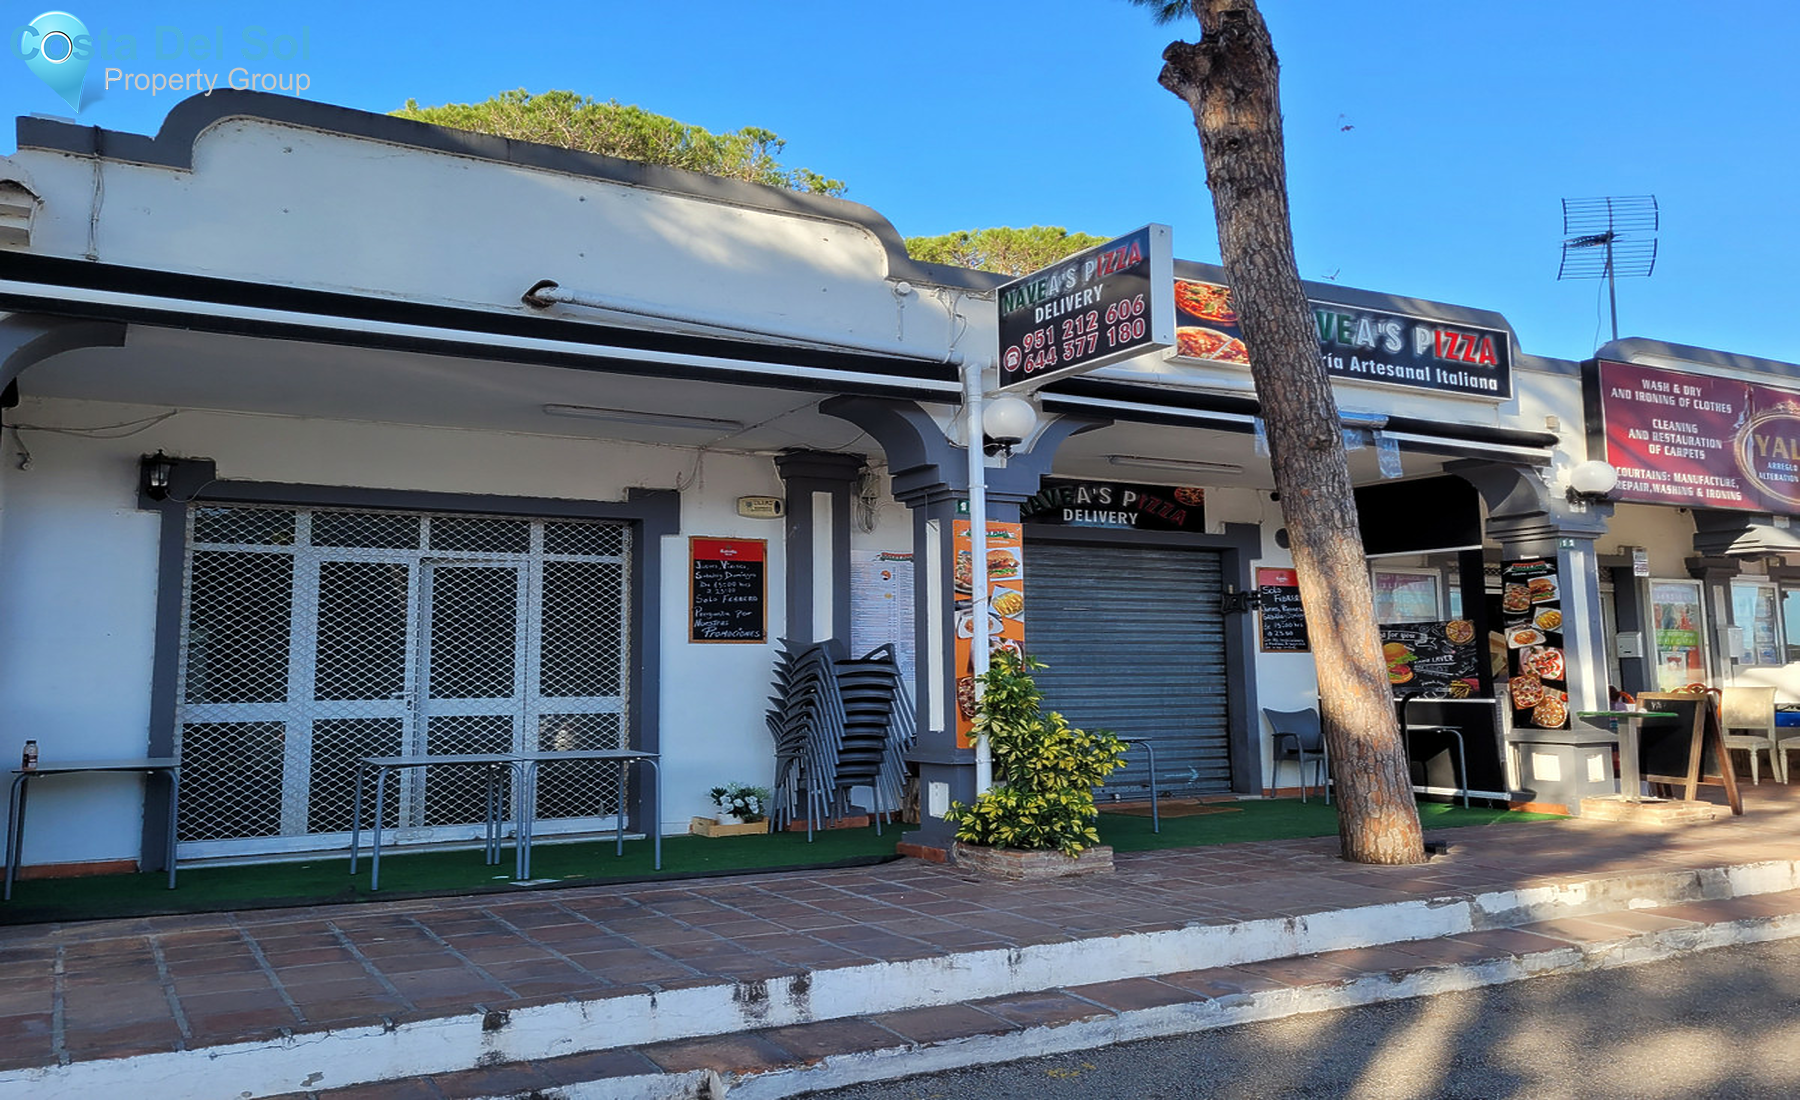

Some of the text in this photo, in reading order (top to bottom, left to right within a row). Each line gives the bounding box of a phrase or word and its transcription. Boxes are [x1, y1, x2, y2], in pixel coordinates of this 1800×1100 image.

[1003, 241, 1143, 315] NAVEA'S PIZZA
[1035, 284, 1103, 323] DELIVERY
[1023, 294, 1145, 352] 951 212 606
[1024, 317, 1145, 373] 644 377 180
[1312, 309, 1498, 366] VEA'S PIZZA
[1350, 356, 1430, 381] Artesanal
[1436, 366, 1498, 391] Italiana
[1611, 387, 1732, 414] AND IRONING OF CLOTHES
[1641, 379, 1702, 397] WASH & DRY
[1628, 428, 1723, 449] AND RESTAURATION
[1652, 418, 1698, 434] CLEANING
[1649, 444, 1706, 460] OF CARPETS
[1616, 467, 1739, 489] COURTAINS: MANUFACTURE,
[1696, 487, 1704, 497] &
[1706, 488, 1742, 501] IRONING
[1063, 508, 1138, 525] DELIVERY
[1122, 490, 1187, 527] PIZZA
